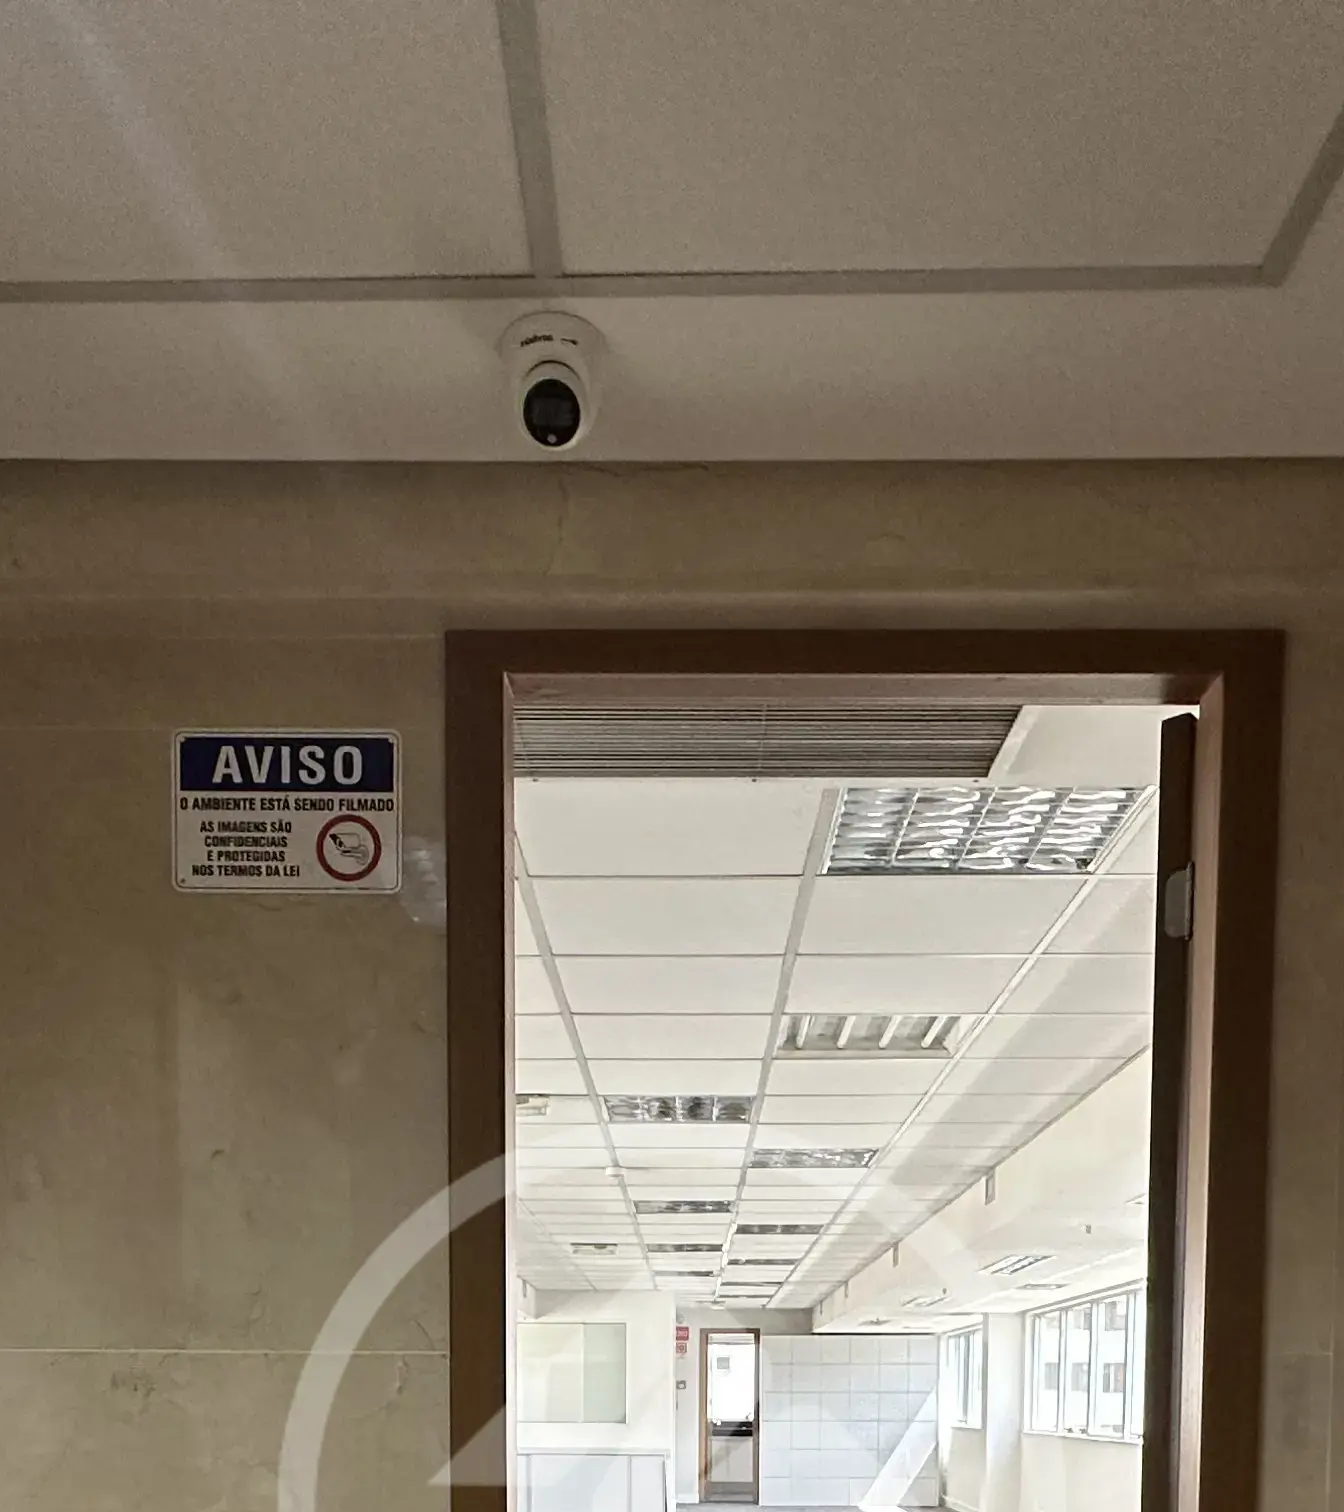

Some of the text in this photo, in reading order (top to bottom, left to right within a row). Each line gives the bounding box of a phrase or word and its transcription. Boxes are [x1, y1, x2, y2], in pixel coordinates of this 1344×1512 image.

[212, 745, 363, 785] AVISO
[180, 795, 394, 812] O AMBIENTE ESTÁ SENDO FILMADO
[200, 818, 292, 833] AS IMAGENS SÃO
[204, 836, 288, 848] CONFIDENCIAIS
[207, 850, 285, 862] E PROTEGIDAS
[192, 865, 300, 877] NOS TERMOS DA LEI
